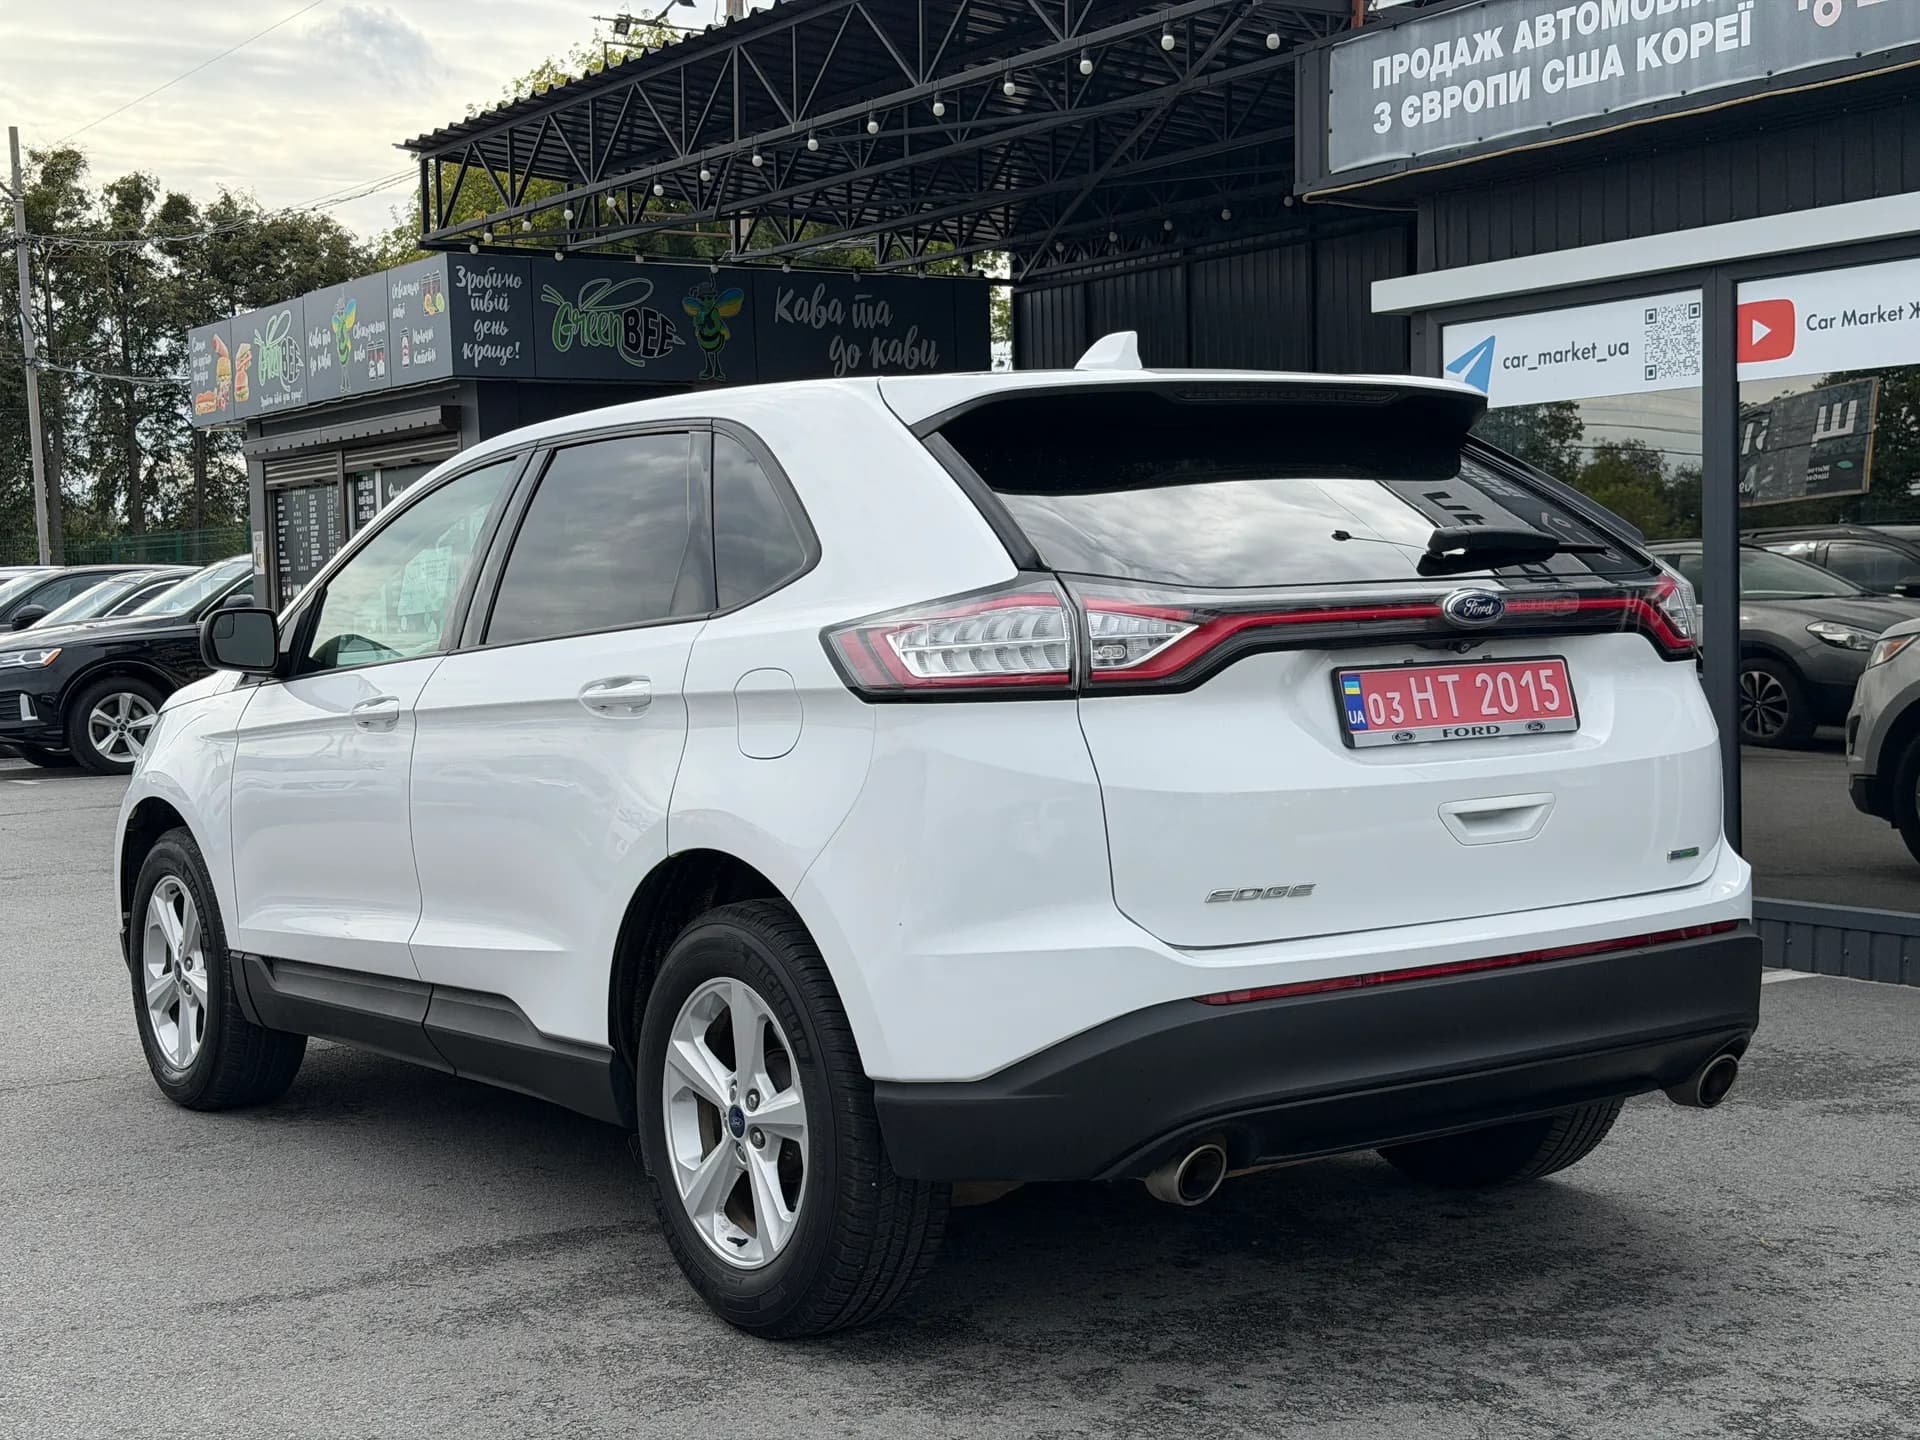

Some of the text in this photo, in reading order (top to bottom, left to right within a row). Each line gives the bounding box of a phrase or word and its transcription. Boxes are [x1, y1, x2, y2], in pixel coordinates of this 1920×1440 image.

[1373, 27, 1503, 89] ПРОДАЖ
[1373, 1, 1754, 134] З ЄВРОПИ США КОРЕЇ
[456, 265, 523, 295] Зробимо
[470, 289, 510, 312] твій
[775, 282, 893, 329] Кава та
[473, 319, 510, 341] день
[1806, 313, 1837, 331] Car
[1841, 304, 1904, 328] Market
[461, 341, 521, 368] краще!
[829, 325, 940, 377] до кави
[1503, 341, 1630, 371] car_market_ua
[1368, 692, 1404, 725] 03
[1475, 669, 1561, 716] 2015
[1349, 710, 1366, 725] UA
[1442, 724, 1501, 738] FORD
[1204, 883, 1317, 904] EDGE
